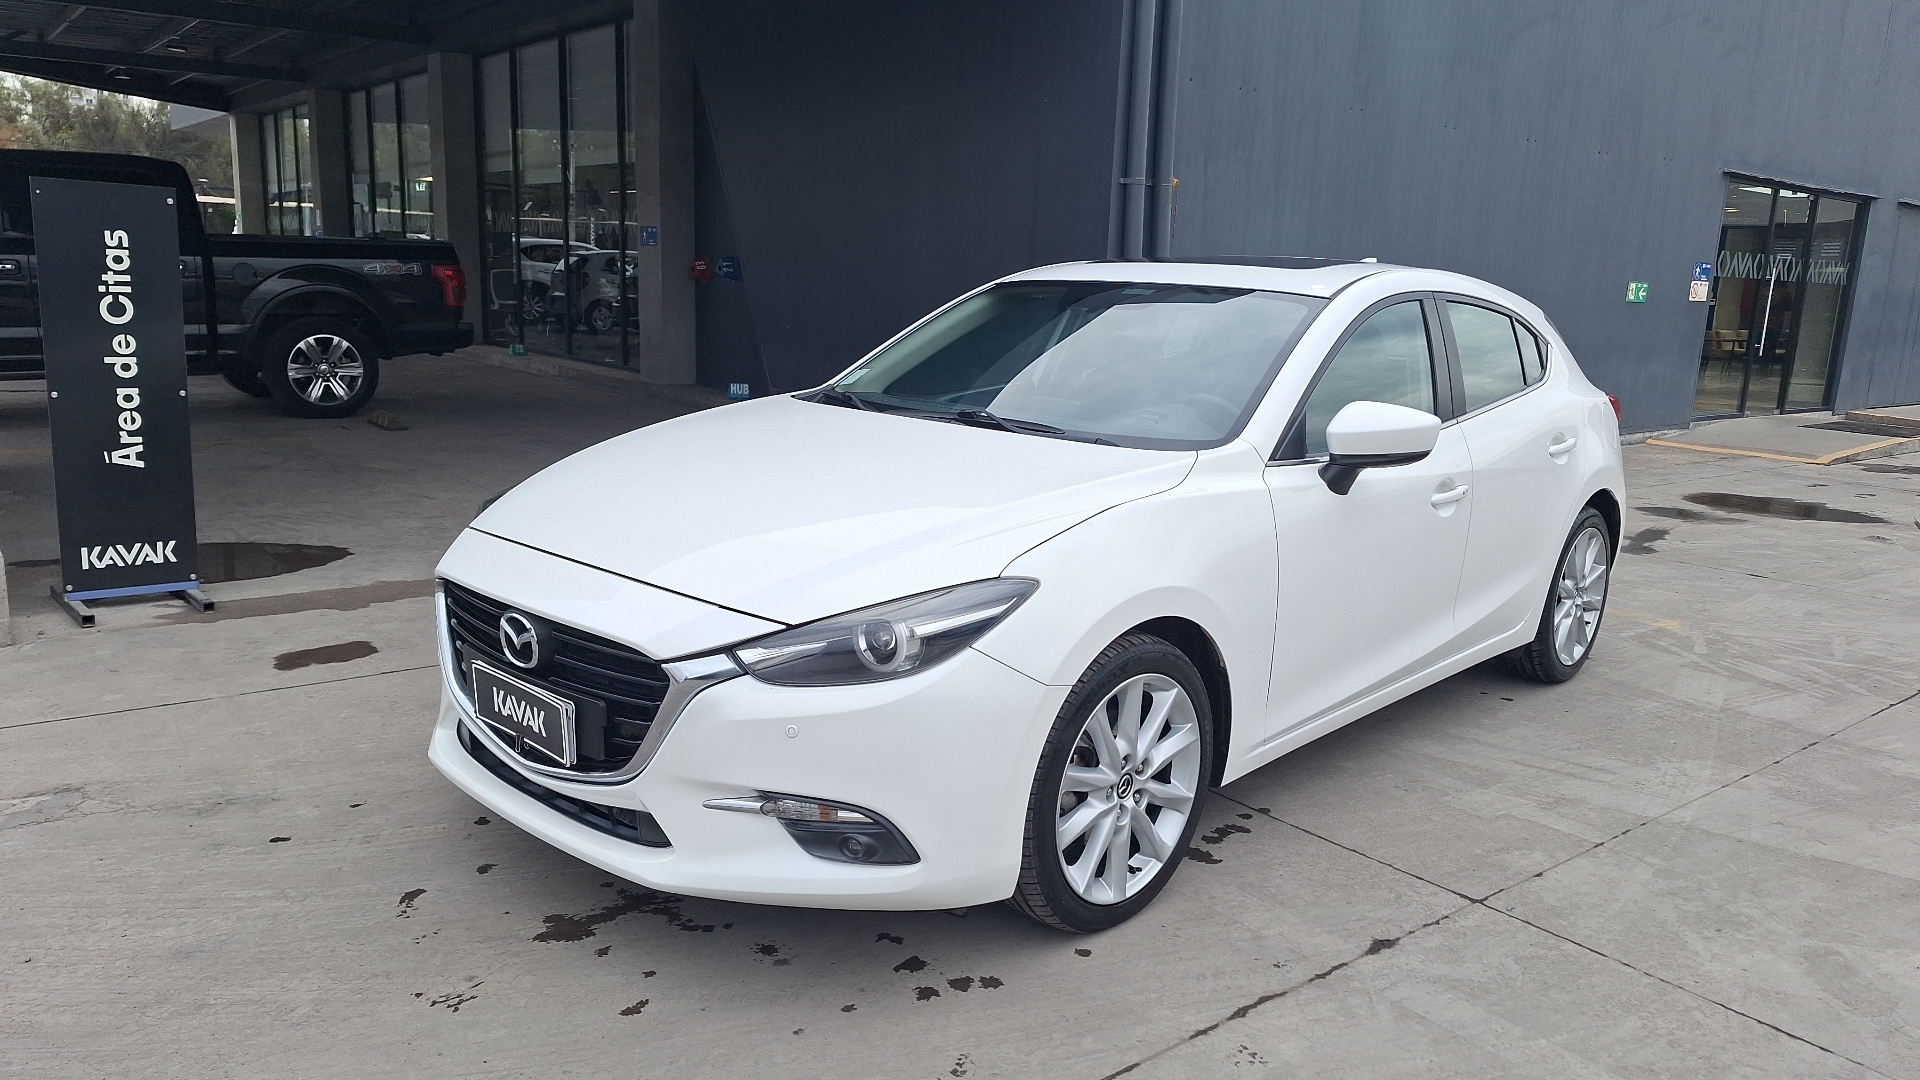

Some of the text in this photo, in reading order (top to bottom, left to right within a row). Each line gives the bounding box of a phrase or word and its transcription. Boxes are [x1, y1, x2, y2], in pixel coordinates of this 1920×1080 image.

[98, 229, 145, 468] Área de Citas
[730, 383, 749, 395] HUB
[81, 540, 177, 570] KAVAK
[493, 686, 547, 738] KAVAK
